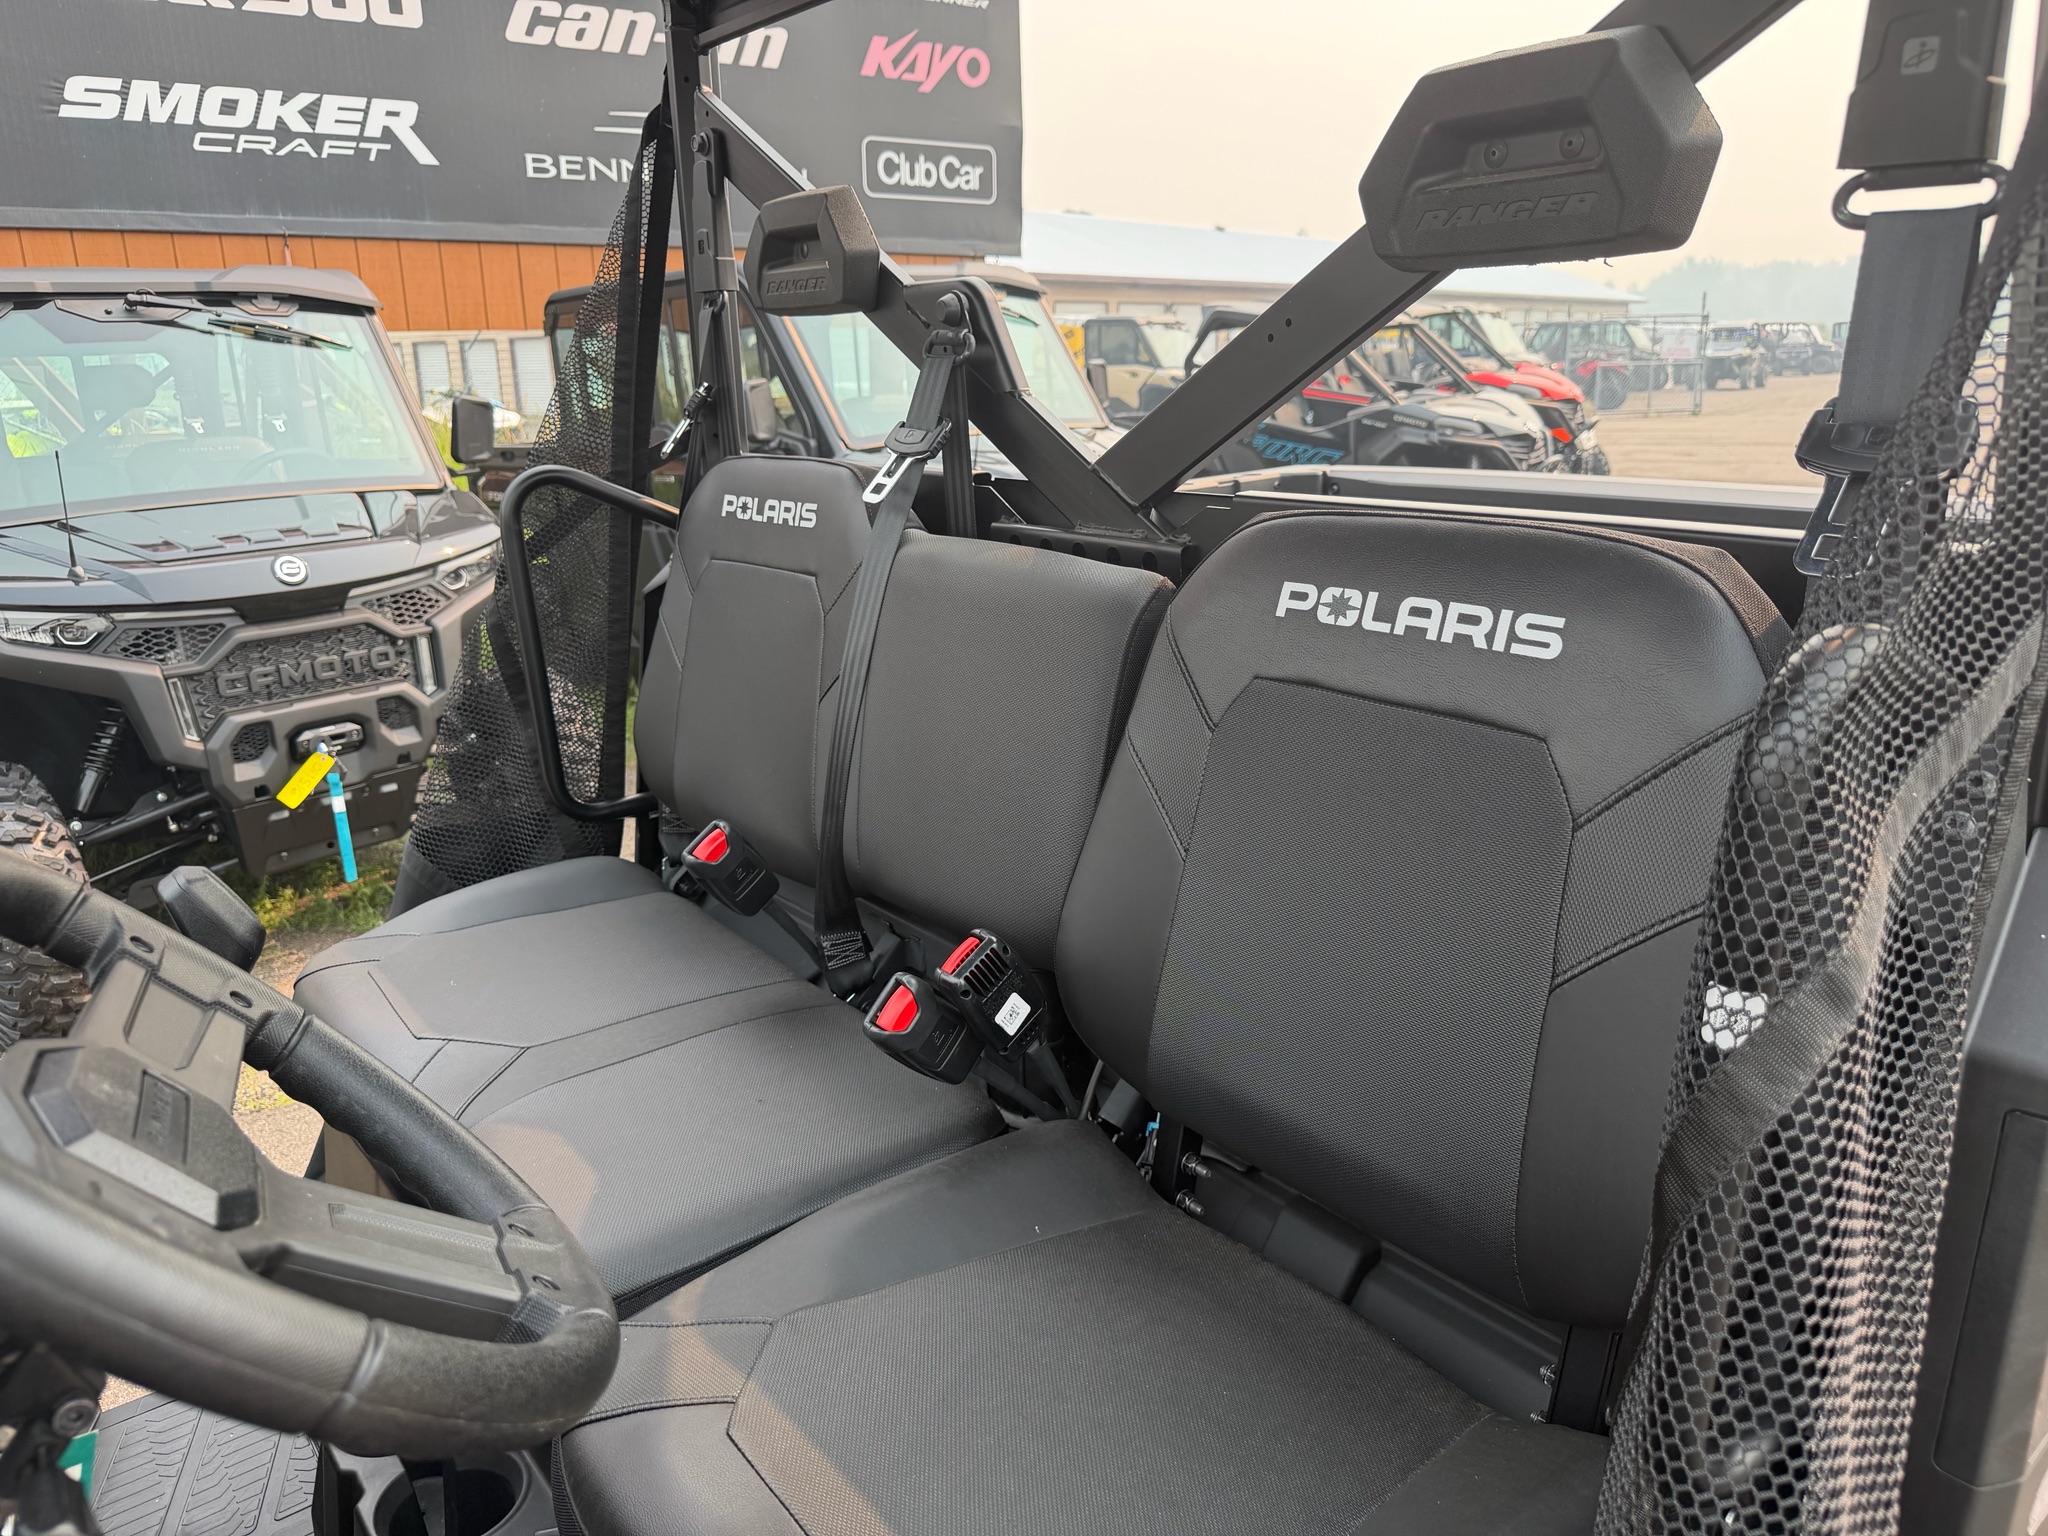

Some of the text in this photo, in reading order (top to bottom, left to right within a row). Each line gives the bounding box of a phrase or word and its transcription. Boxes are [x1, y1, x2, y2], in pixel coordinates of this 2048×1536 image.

[505, 0, 789, 69] can-m
[860, 28, 991, 93] KAYO
[58, 75, 440, 165] SMOKER
[192, 132, 391, 162] CRAFT
[1415, 191, 1598, 231] RANGER
[766, 276, 827, 295] RANGER
[721, 494, 818, 528] POLARIS
[1275, 581, 1566, 660] POLARIS
[217, 645, 397, 697] CFMOTO
